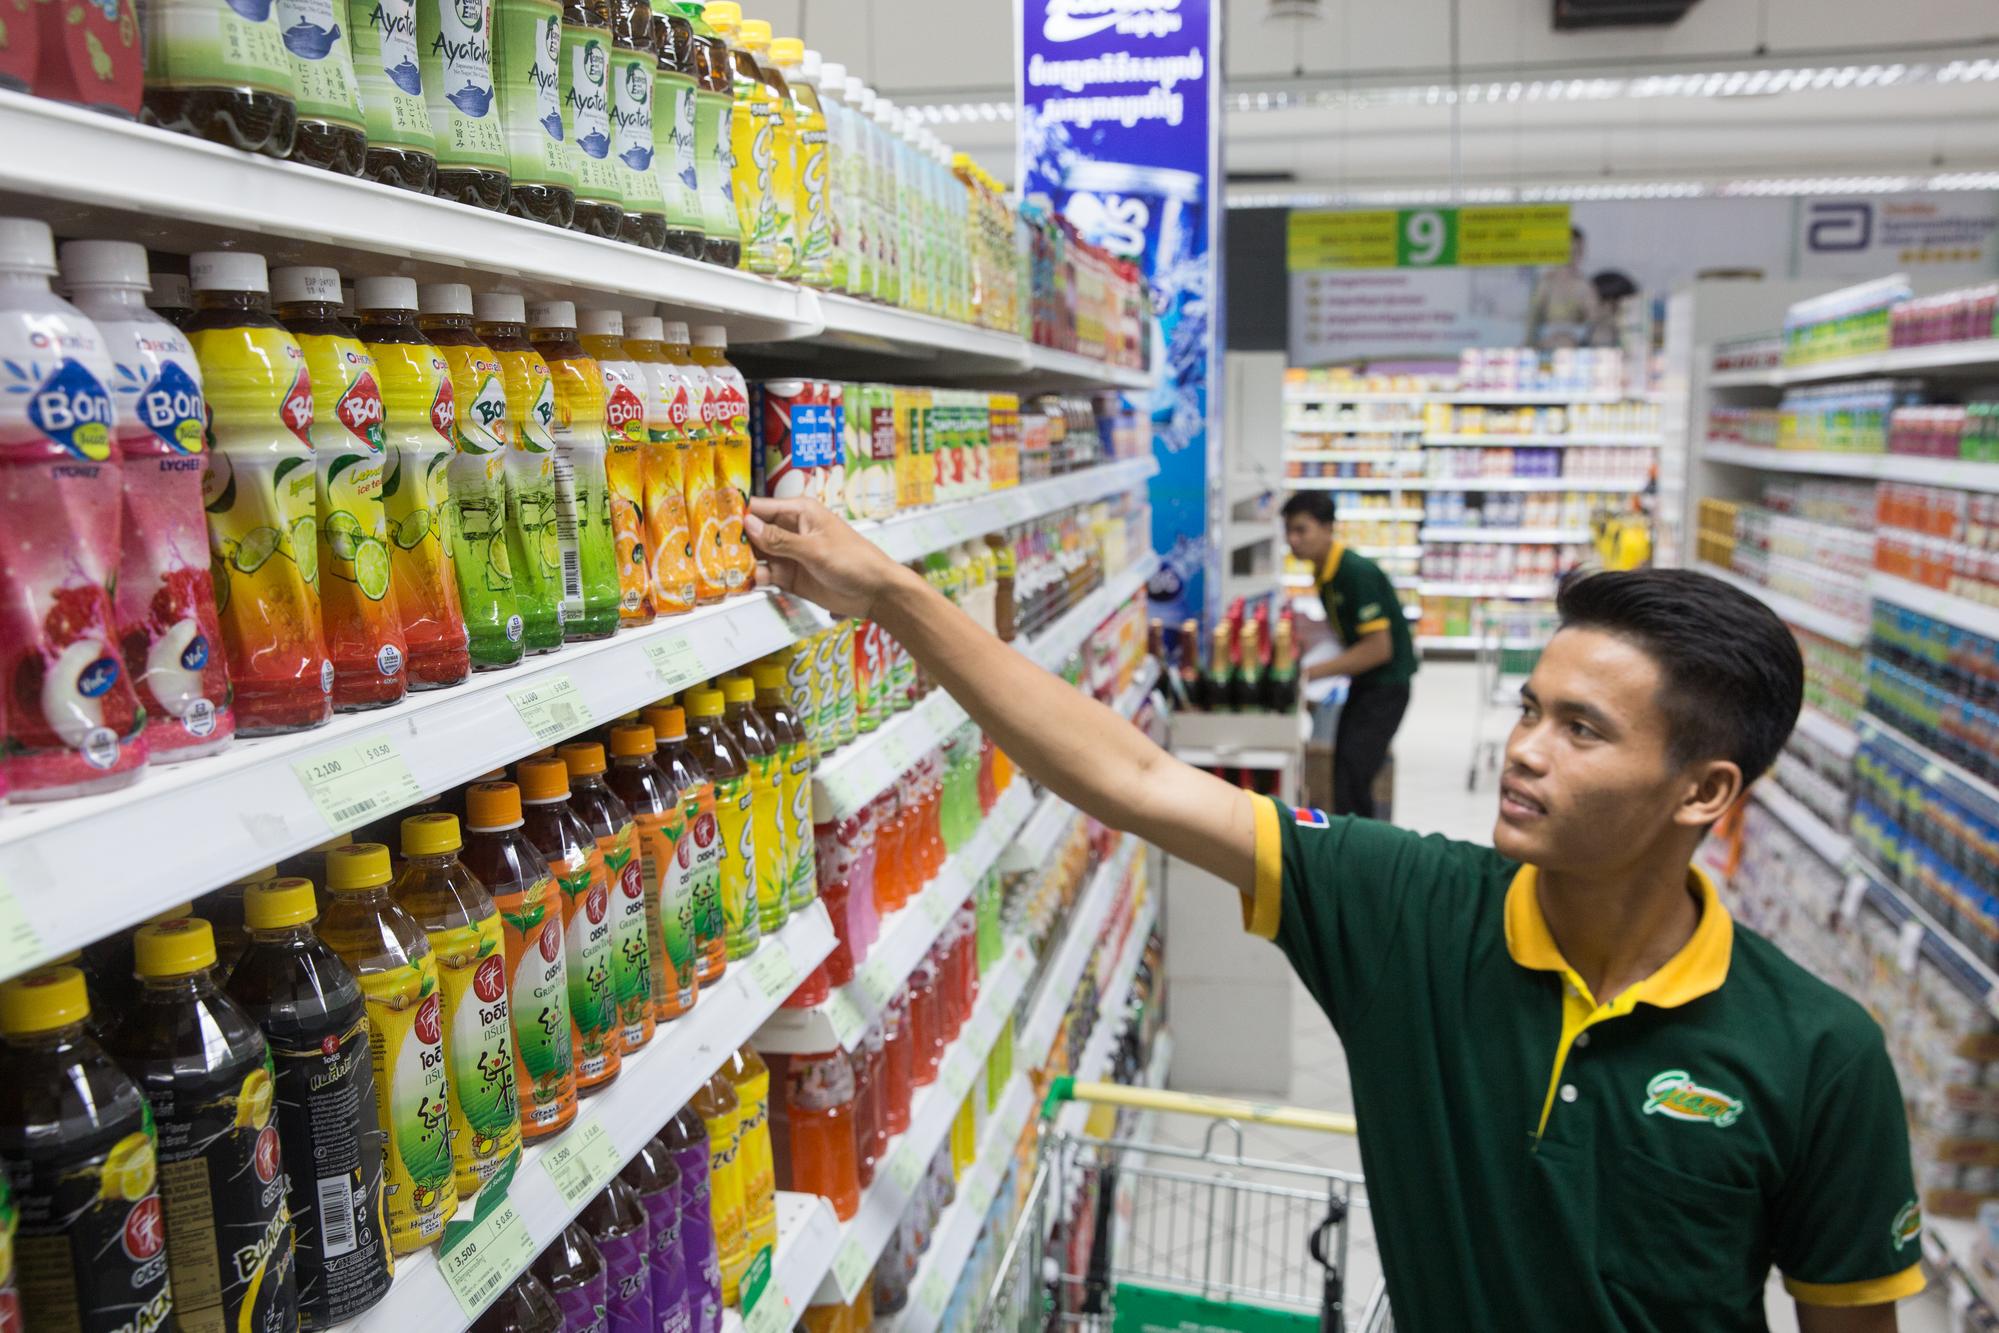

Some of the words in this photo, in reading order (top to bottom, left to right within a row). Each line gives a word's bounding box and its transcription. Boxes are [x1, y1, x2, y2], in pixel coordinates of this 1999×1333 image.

[369, 2, 416, 42] Ayata
[1406, 212, 1446, 266] 9
[608, 402, 642, 426] Bon
[366, 749, 374, 760] $
[373, 744, 391, 757] 0.50
[313, 760, 342, 779] 2,100
[553, 1147, 571, 1166] 3,500
[495, 1219, 501, 1229] $
[500, 1208, 513, 1224] 0.85
[454, 1242, 477, 1268] 3,500
